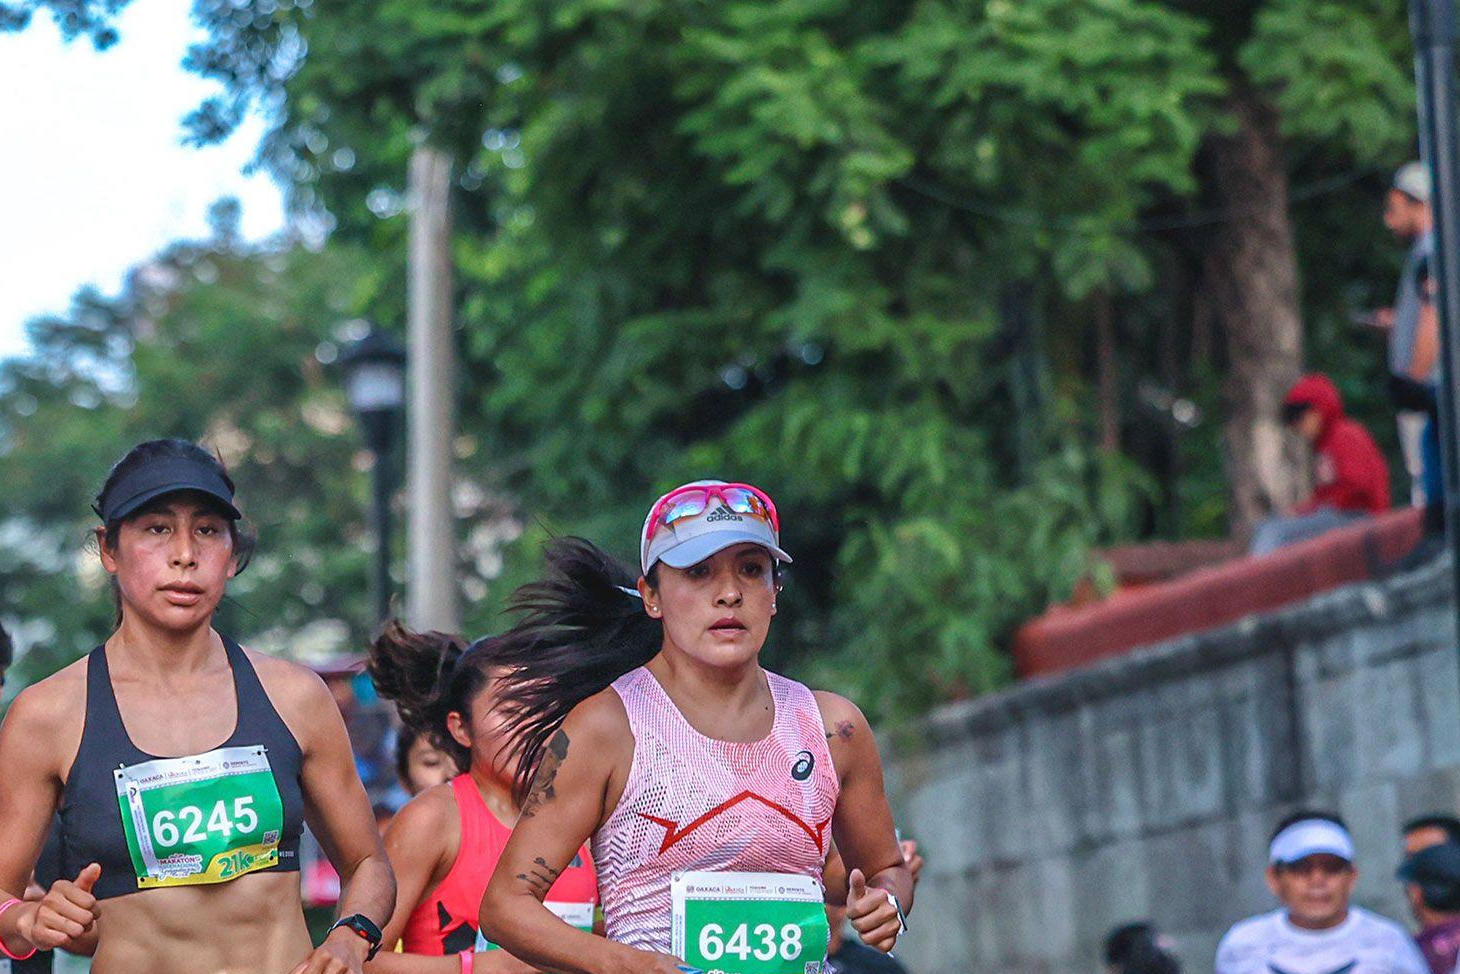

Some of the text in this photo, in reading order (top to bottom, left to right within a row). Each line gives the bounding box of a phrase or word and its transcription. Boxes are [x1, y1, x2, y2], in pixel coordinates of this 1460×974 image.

[706, 513, 743, 522] adidas
[152, 795, 258, 847] 6245
[217, 850, 251, 879] 21k
[699, 923, 802, 961] 6438
